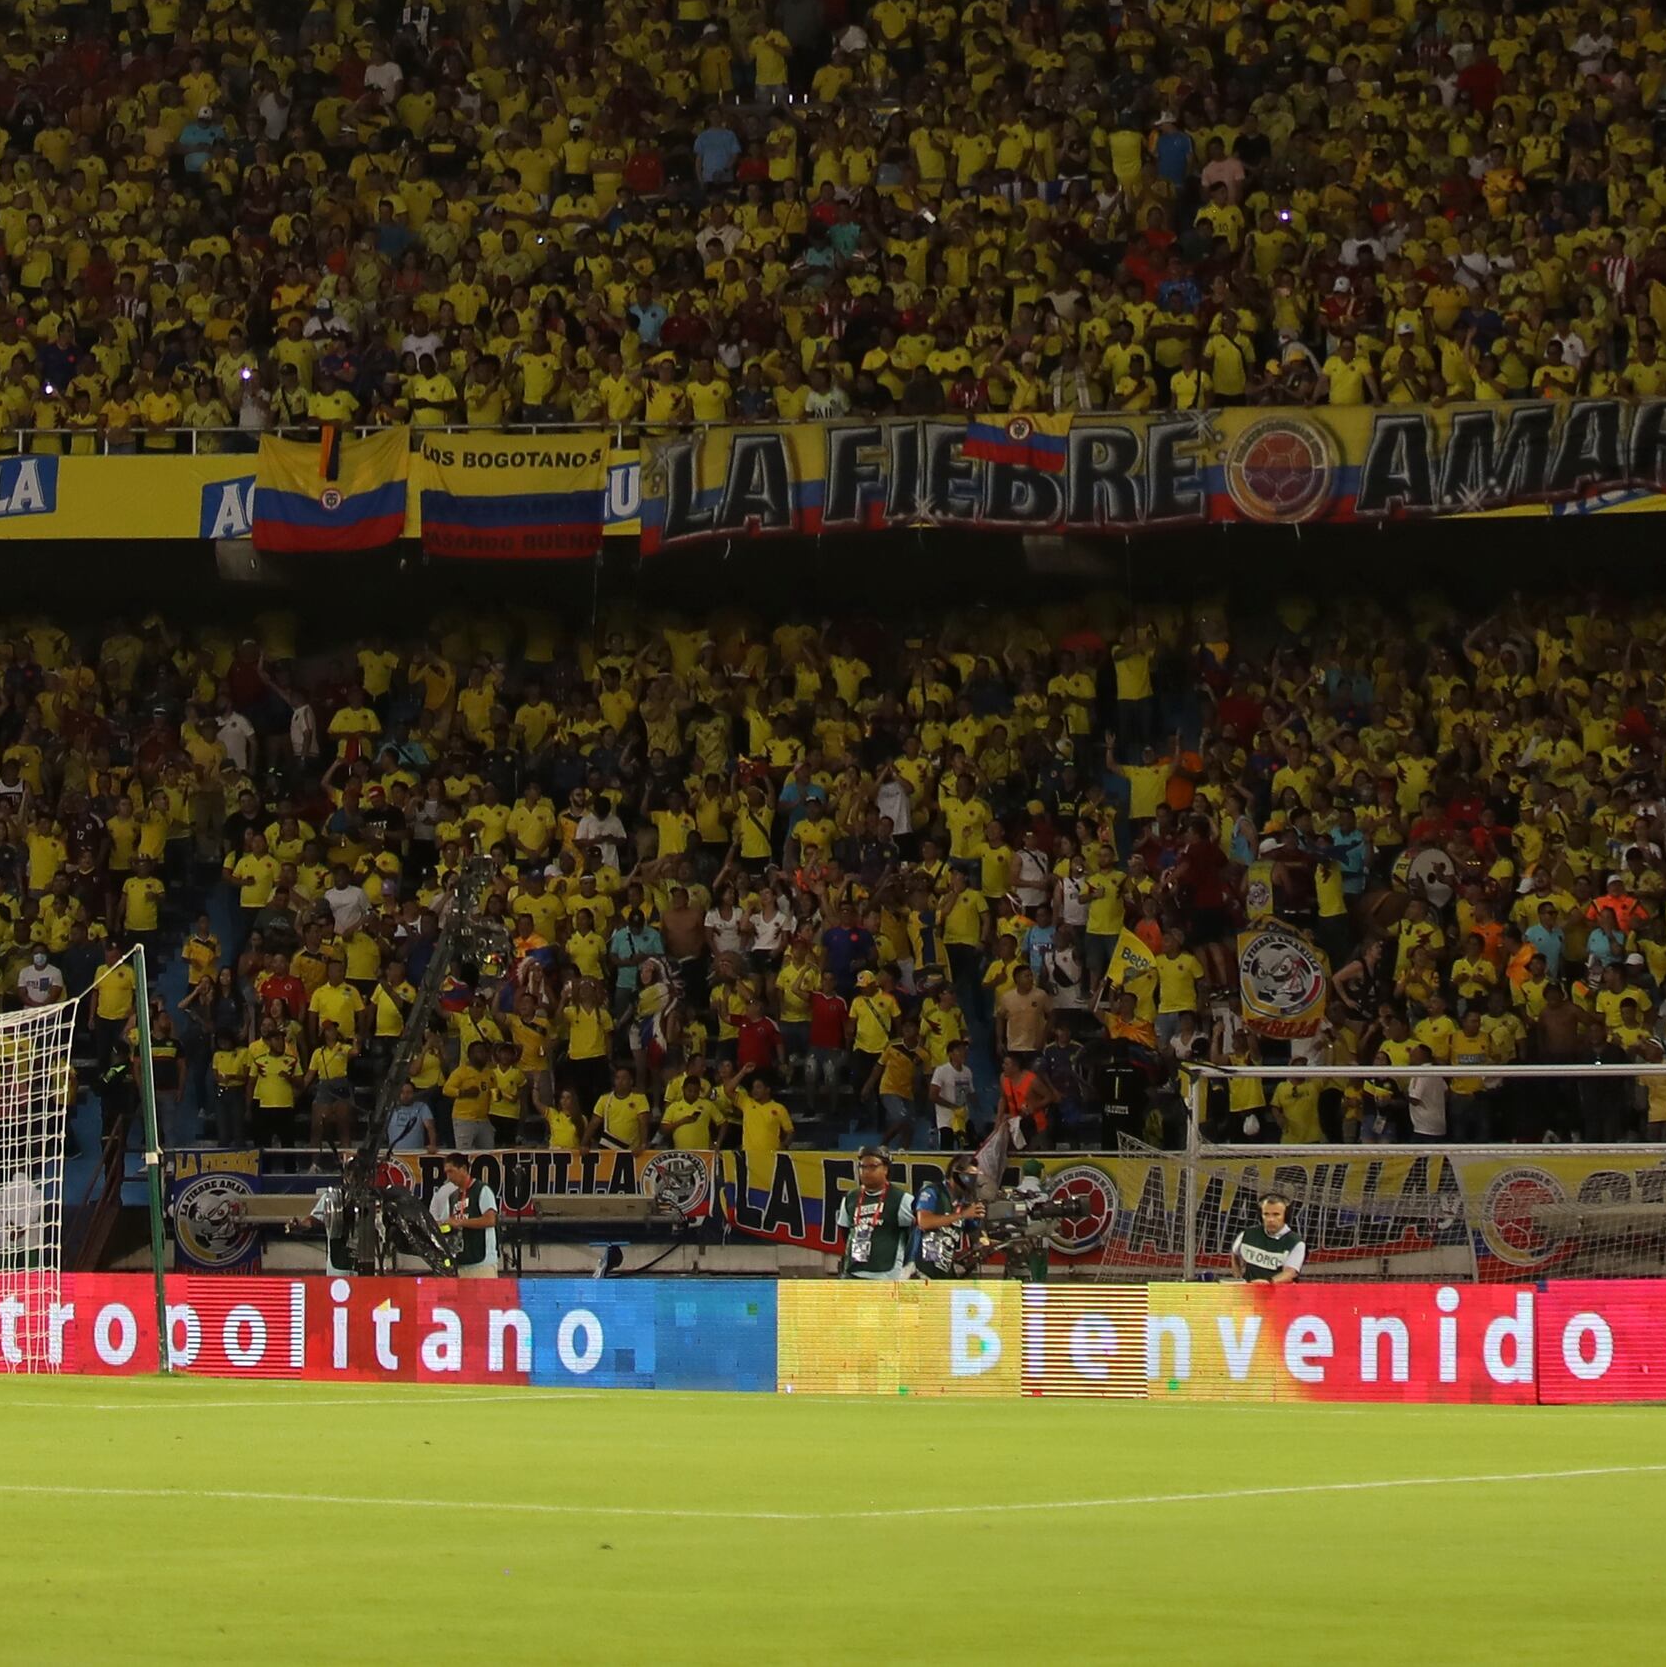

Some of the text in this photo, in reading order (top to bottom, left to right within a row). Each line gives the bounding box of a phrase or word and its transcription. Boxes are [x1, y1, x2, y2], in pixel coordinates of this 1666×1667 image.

[422, 444, 602, 469] LOS BOGOTANOS
[664, 435, 798, 542] LA
[821, 419, 1210, 530] FIEBRE
[175, 1152, 199, 1182] LA
[735, 1150, 807, 1240] LA
[950, 1285, 1614, 1384] Bienvenido
